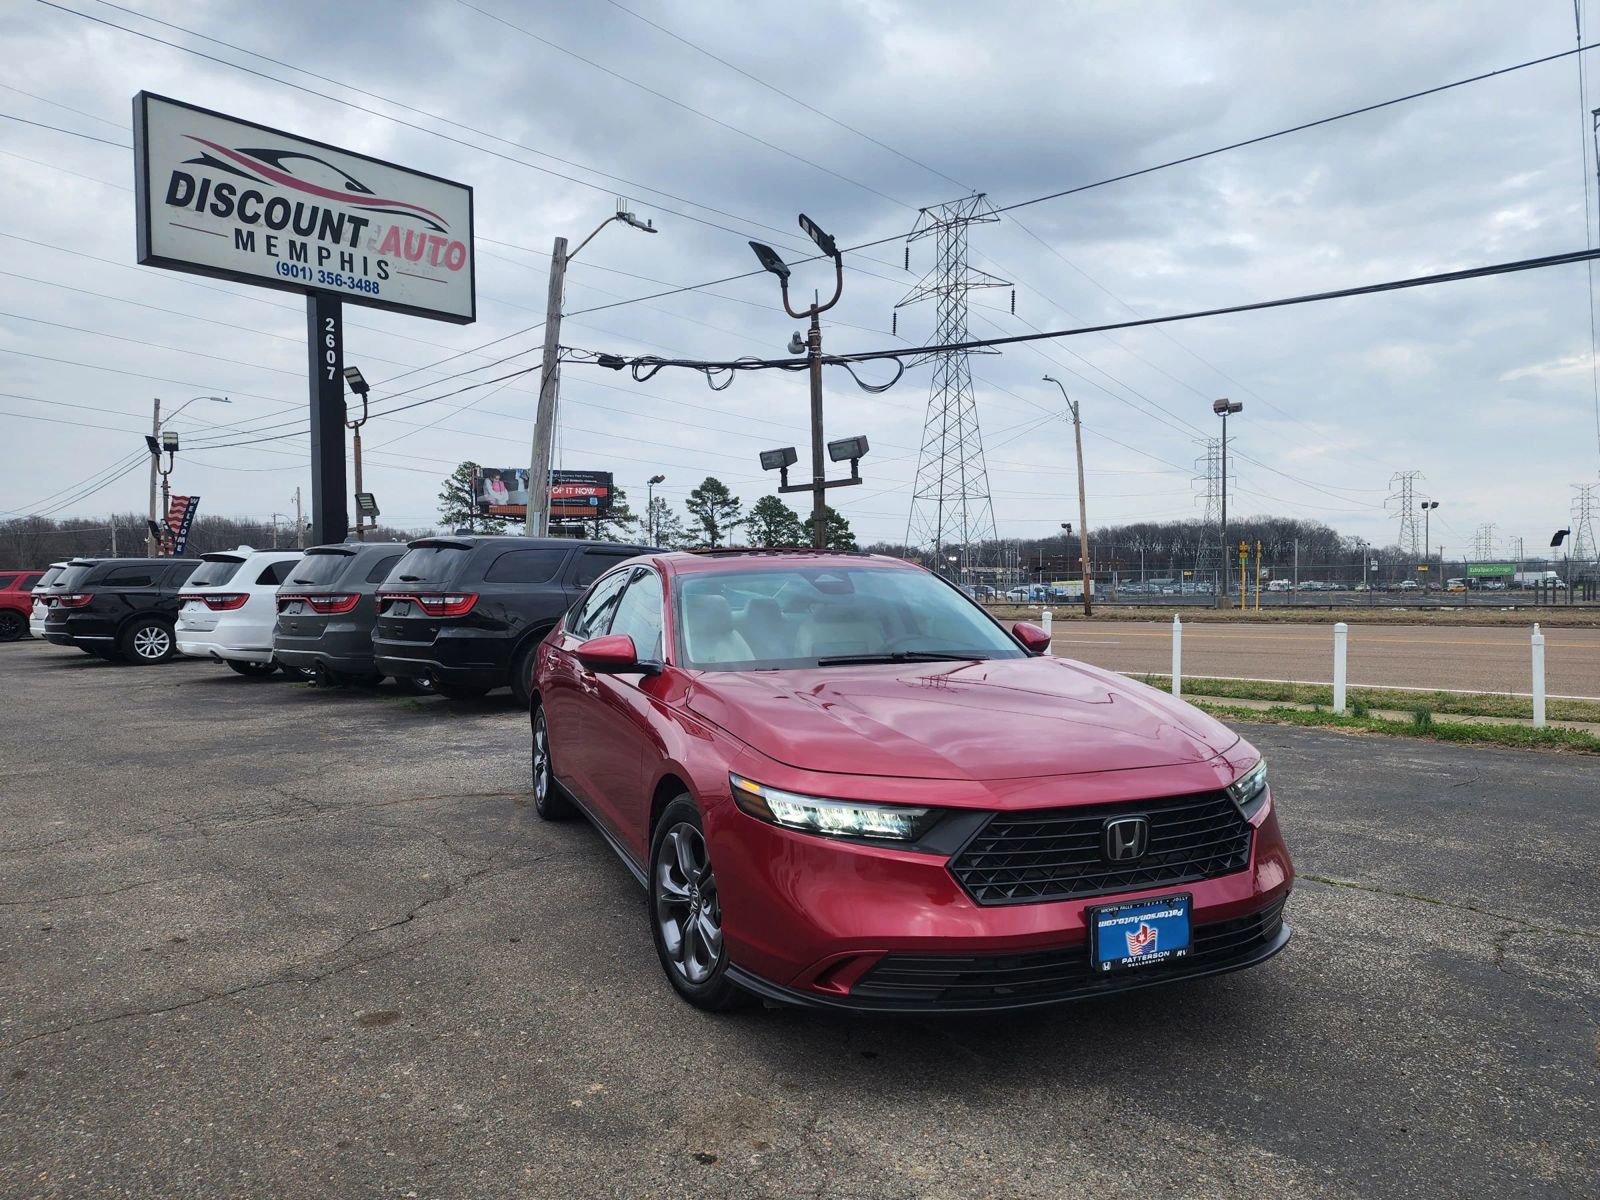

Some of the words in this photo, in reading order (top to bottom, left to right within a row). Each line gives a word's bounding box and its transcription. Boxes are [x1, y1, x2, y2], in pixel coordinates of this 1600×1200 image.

[165, 170, 369, 248] DISCOUNT
[379, 225, 466, 272] AUTO
[234, 228, 389, 280] MEMPHIS
[276, 261, 313, 282] (901)
[318, 270, 380, 295] 356-3488
[325, 317, 336, 380] 2607
[177, 498, 198, 552] WELCOME
[1098, 908, 1183, 927] PattersonAuto.com
[1121, 950, 1170, 964] PATTERSON
